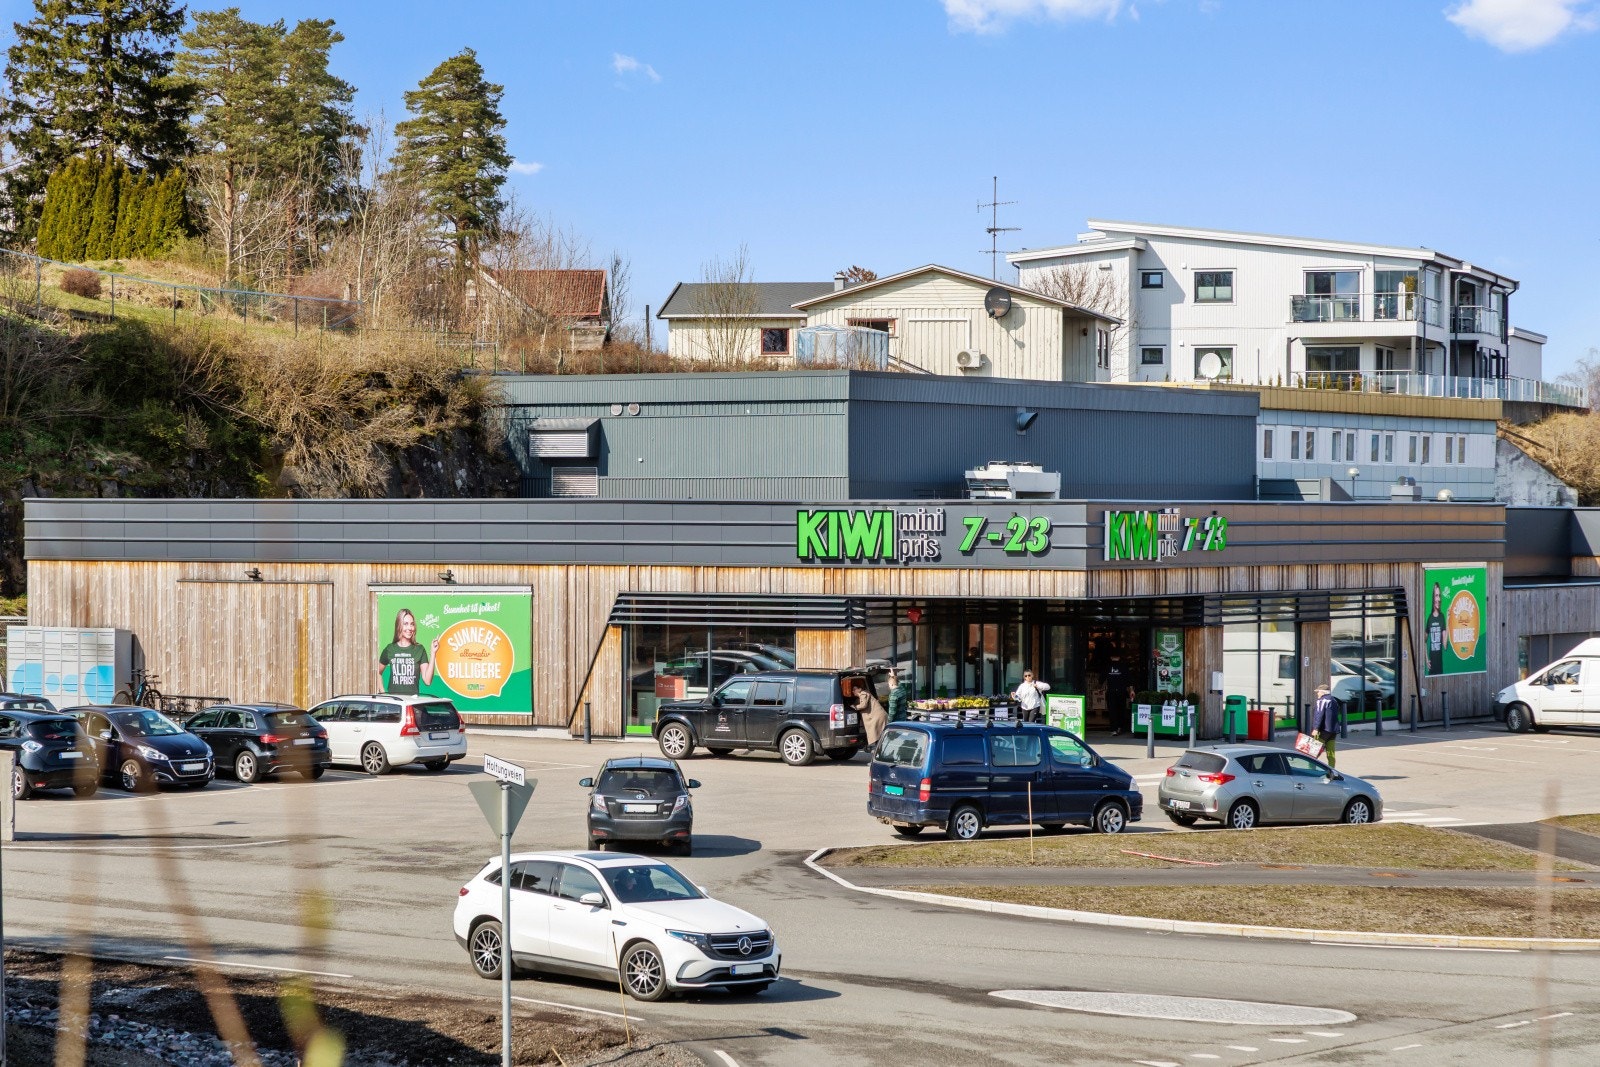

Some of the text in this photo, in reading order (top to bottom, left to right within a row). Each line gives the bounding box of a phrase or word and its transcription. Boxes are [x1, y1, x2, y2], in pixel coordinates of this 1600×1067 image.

[899, 508, 944, 532] mini
[797, 509, 897, 560] KIWI
[958, 516, 1051, 552] 7-23
[1105, 510, 1158, 560] KIWI
[899, 533, 940, 562] pris
[1158, 534, 1178, 561] pris
[447, 626, 502, 652] SUNNERE
[392, 664, 415, 677] ALDRI
[447, 662, 502, 679] BILLIGERE
[486, 758, 523, 781] Holtungveien
